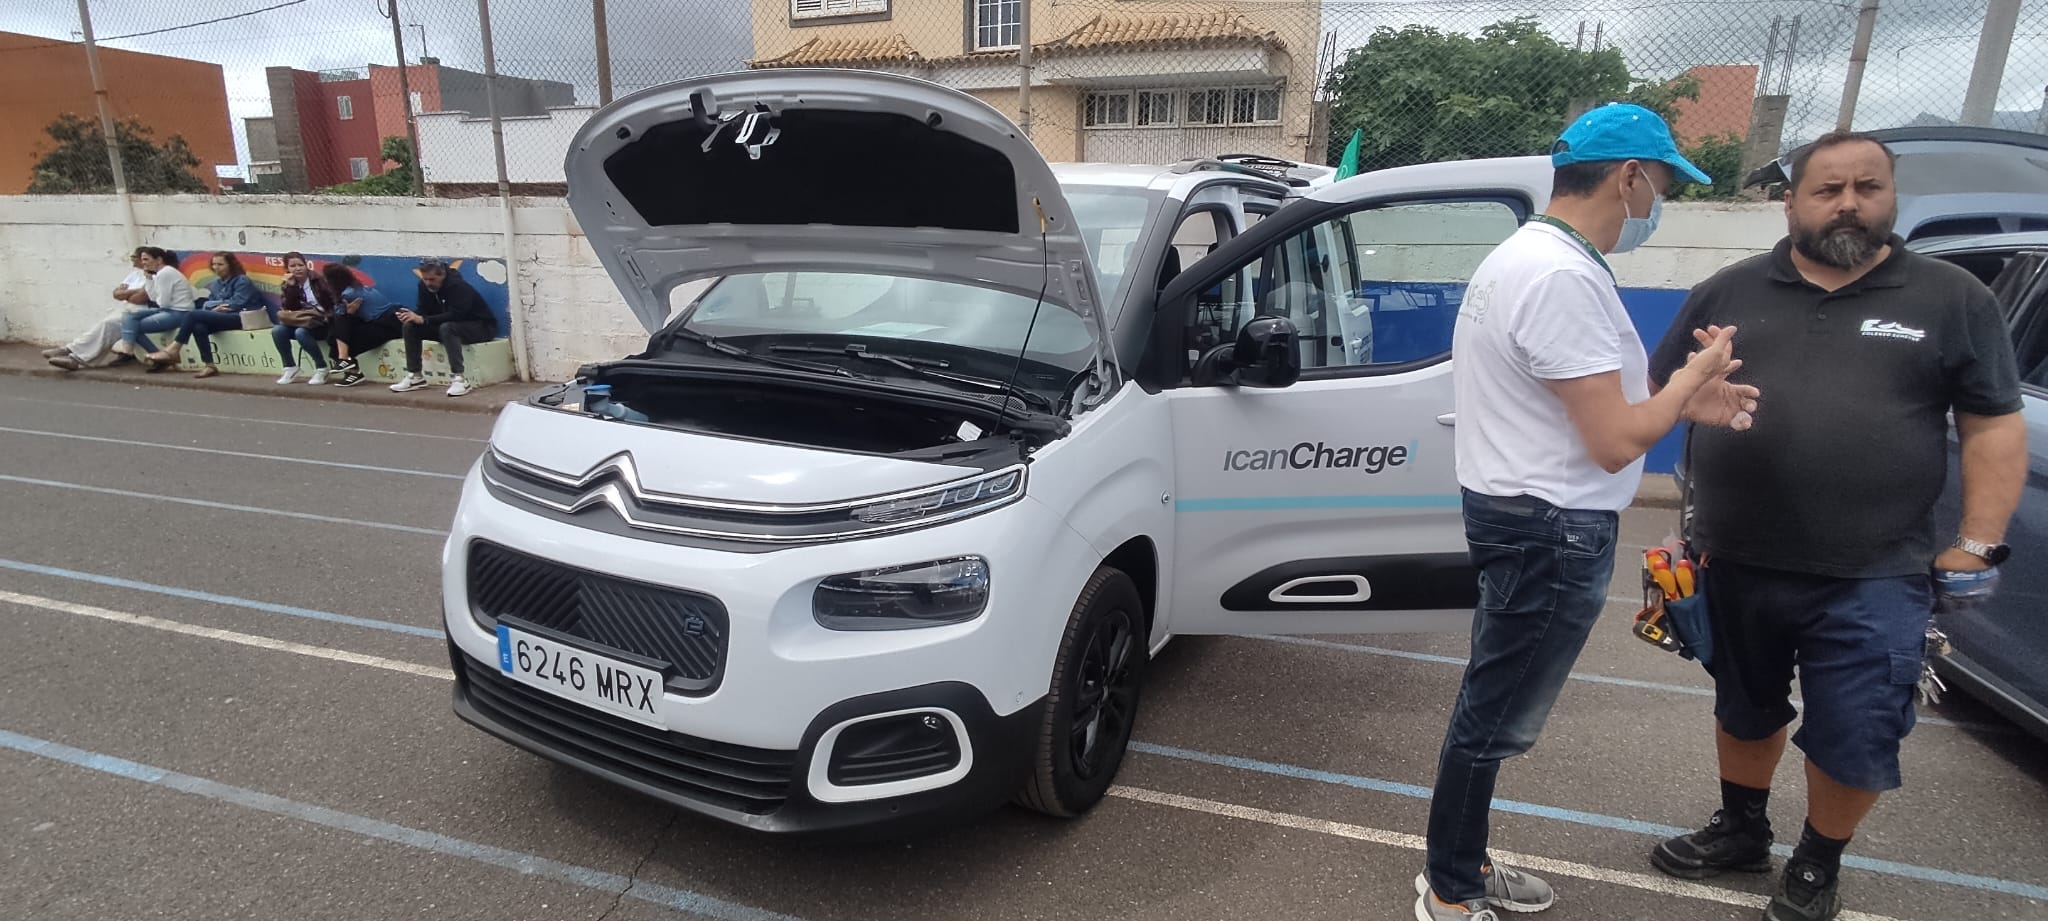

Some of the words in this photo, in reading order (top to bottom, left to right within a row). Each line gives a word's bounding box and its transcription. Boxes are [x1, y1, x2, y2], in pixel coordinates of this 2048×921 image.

[265, 256, 314, 270] RESO
[209, 341, 256, 368] Banco
[261, 351, 276, 369] de
[502, 652, 510, 664] E
[517, 640, 585, 692] 6246
[595, 663, 655, 714] MRX
